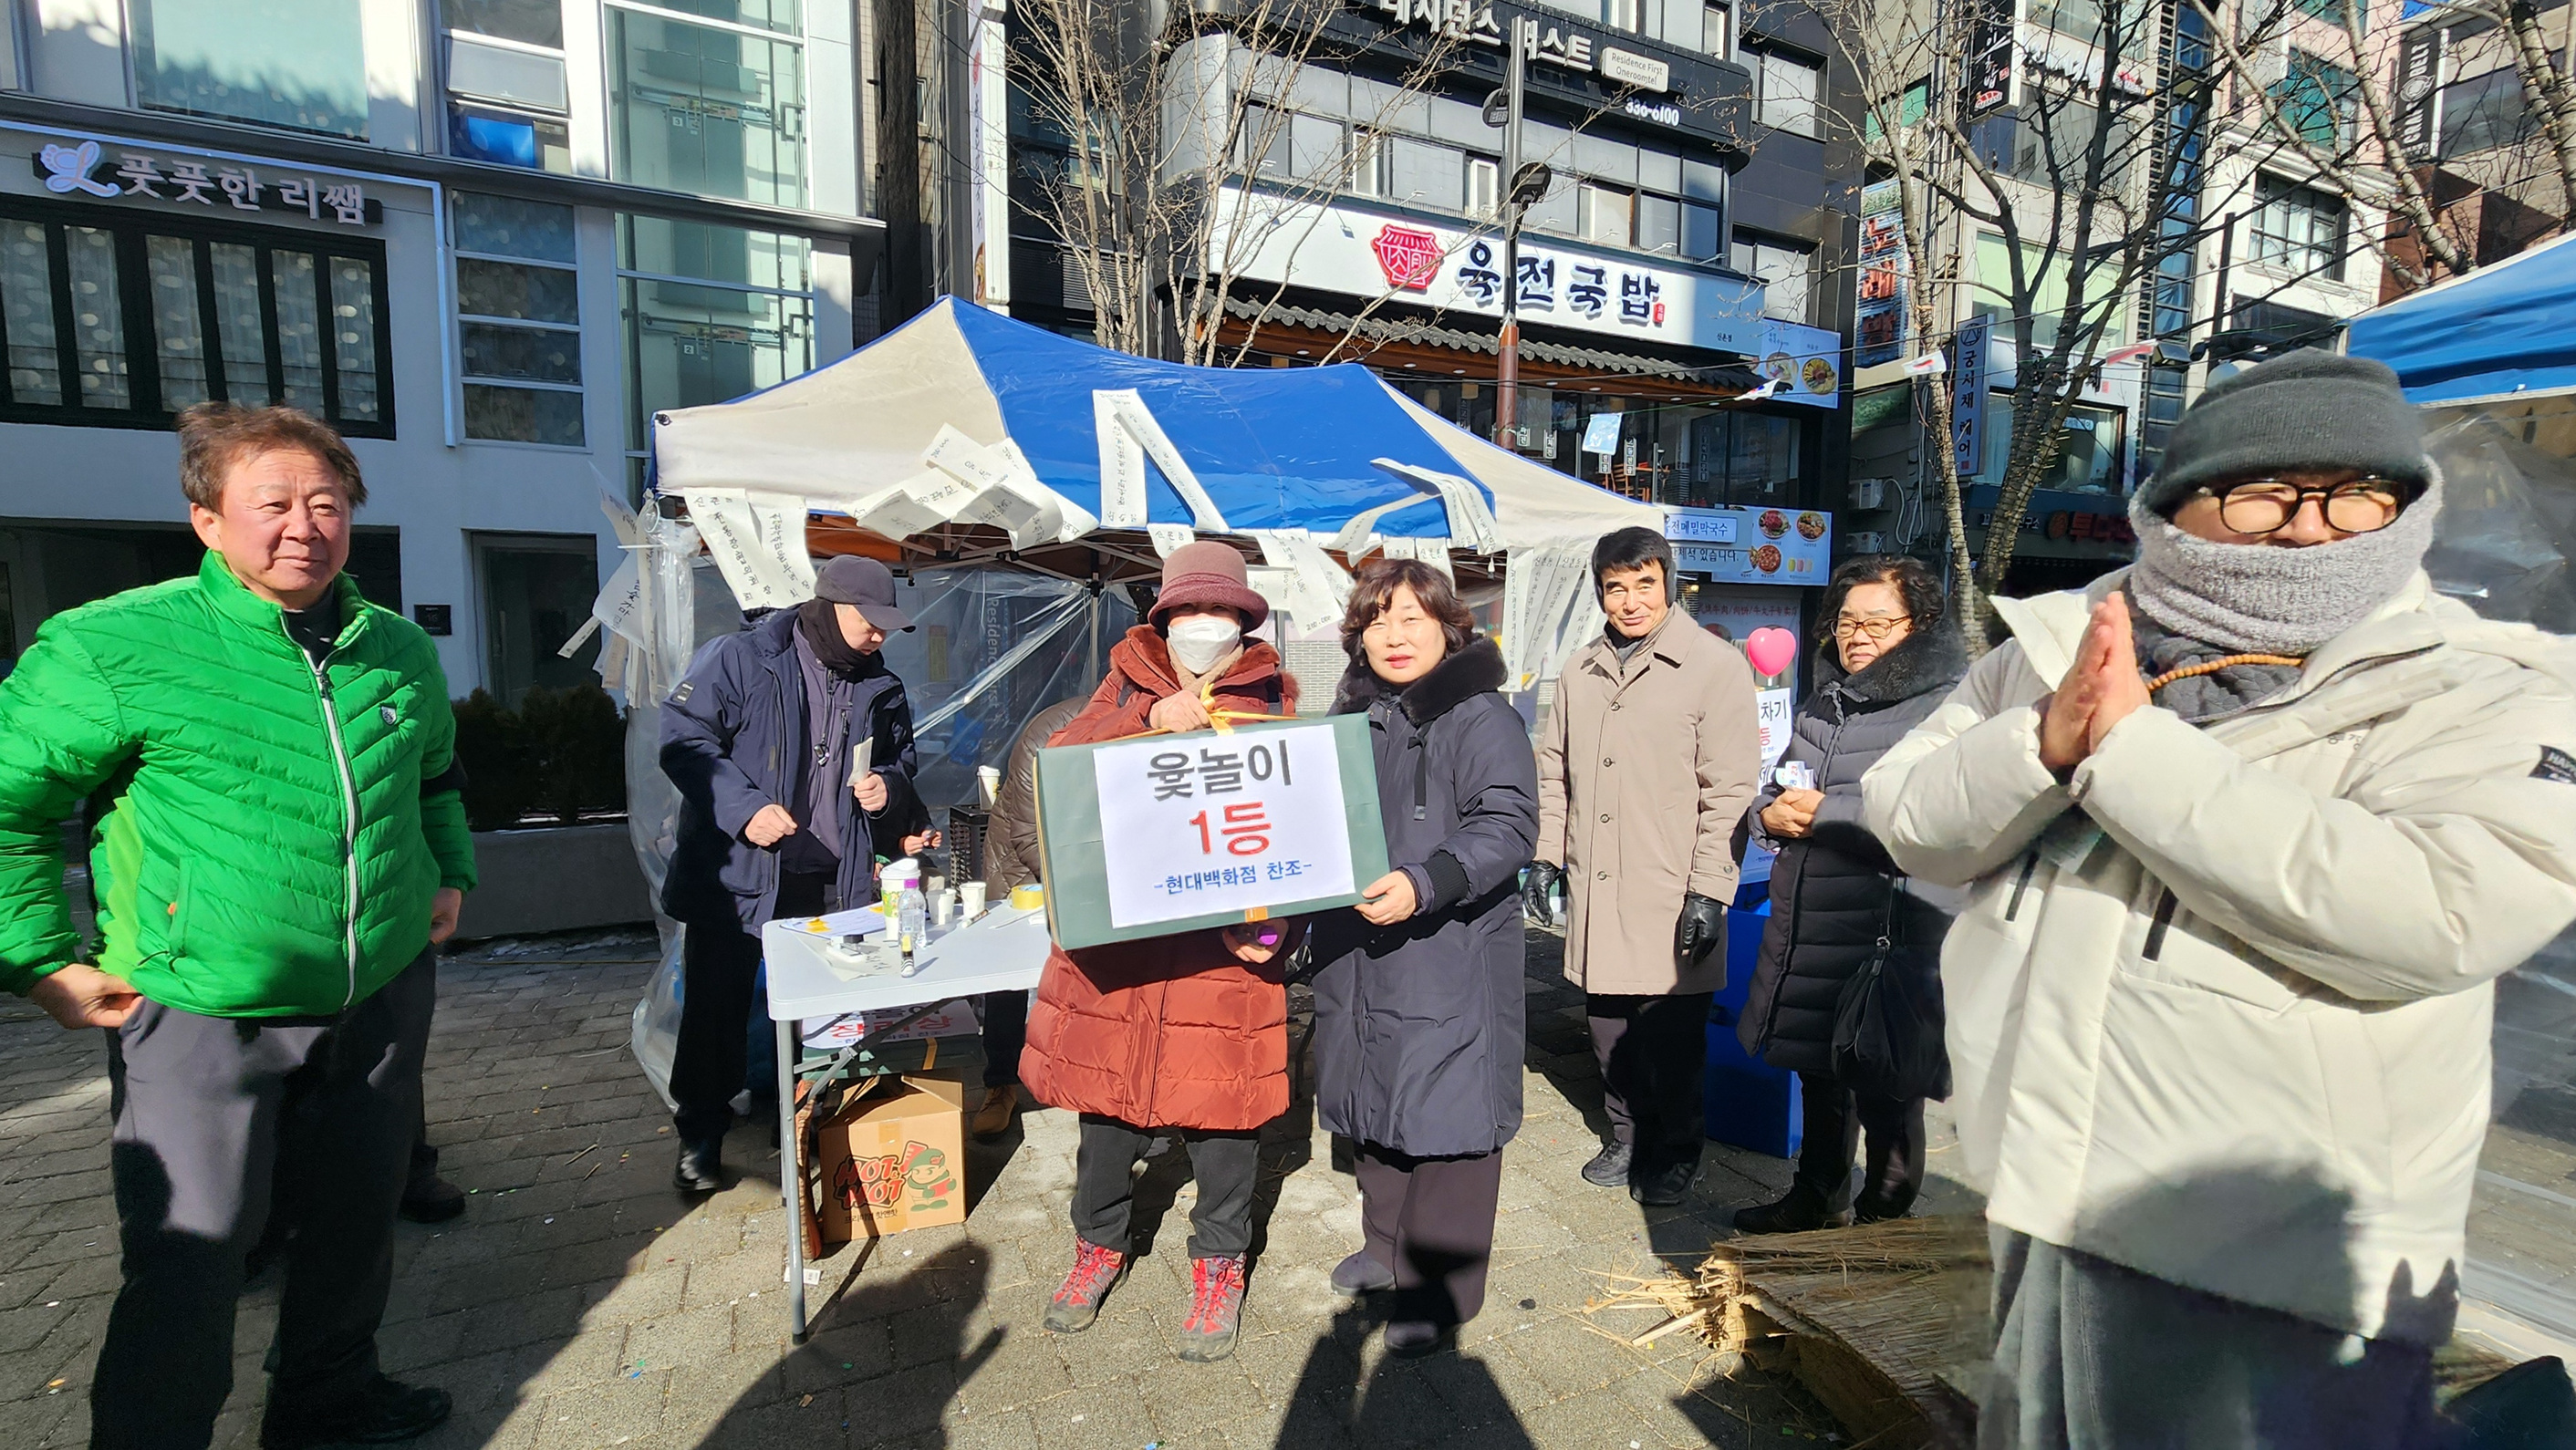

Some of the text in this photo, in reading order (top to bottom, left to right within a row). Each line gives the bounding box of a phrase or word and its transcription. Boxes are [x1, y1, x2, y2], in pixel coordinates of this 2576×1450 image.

[1612, 52, 1663, 76] Residence First
[1615, 66, 1657, 85] Oneroomtel
[1625, 96, 1679, 127] 336-6100
[116, 152, 367, 226] 풋풋한 리쌤
[1459, 241, 1658, 320] 육전국밥
[1861, 215, 1899, 352] 노래방
[1699, 549, 1740, 563] 있습니다.
[1147, 739, 1292, 803] 윷놀이
[1189, 801, 1272, 856] 1등
[1153, 859, 1313, 896] -현대백화점 찬조-
